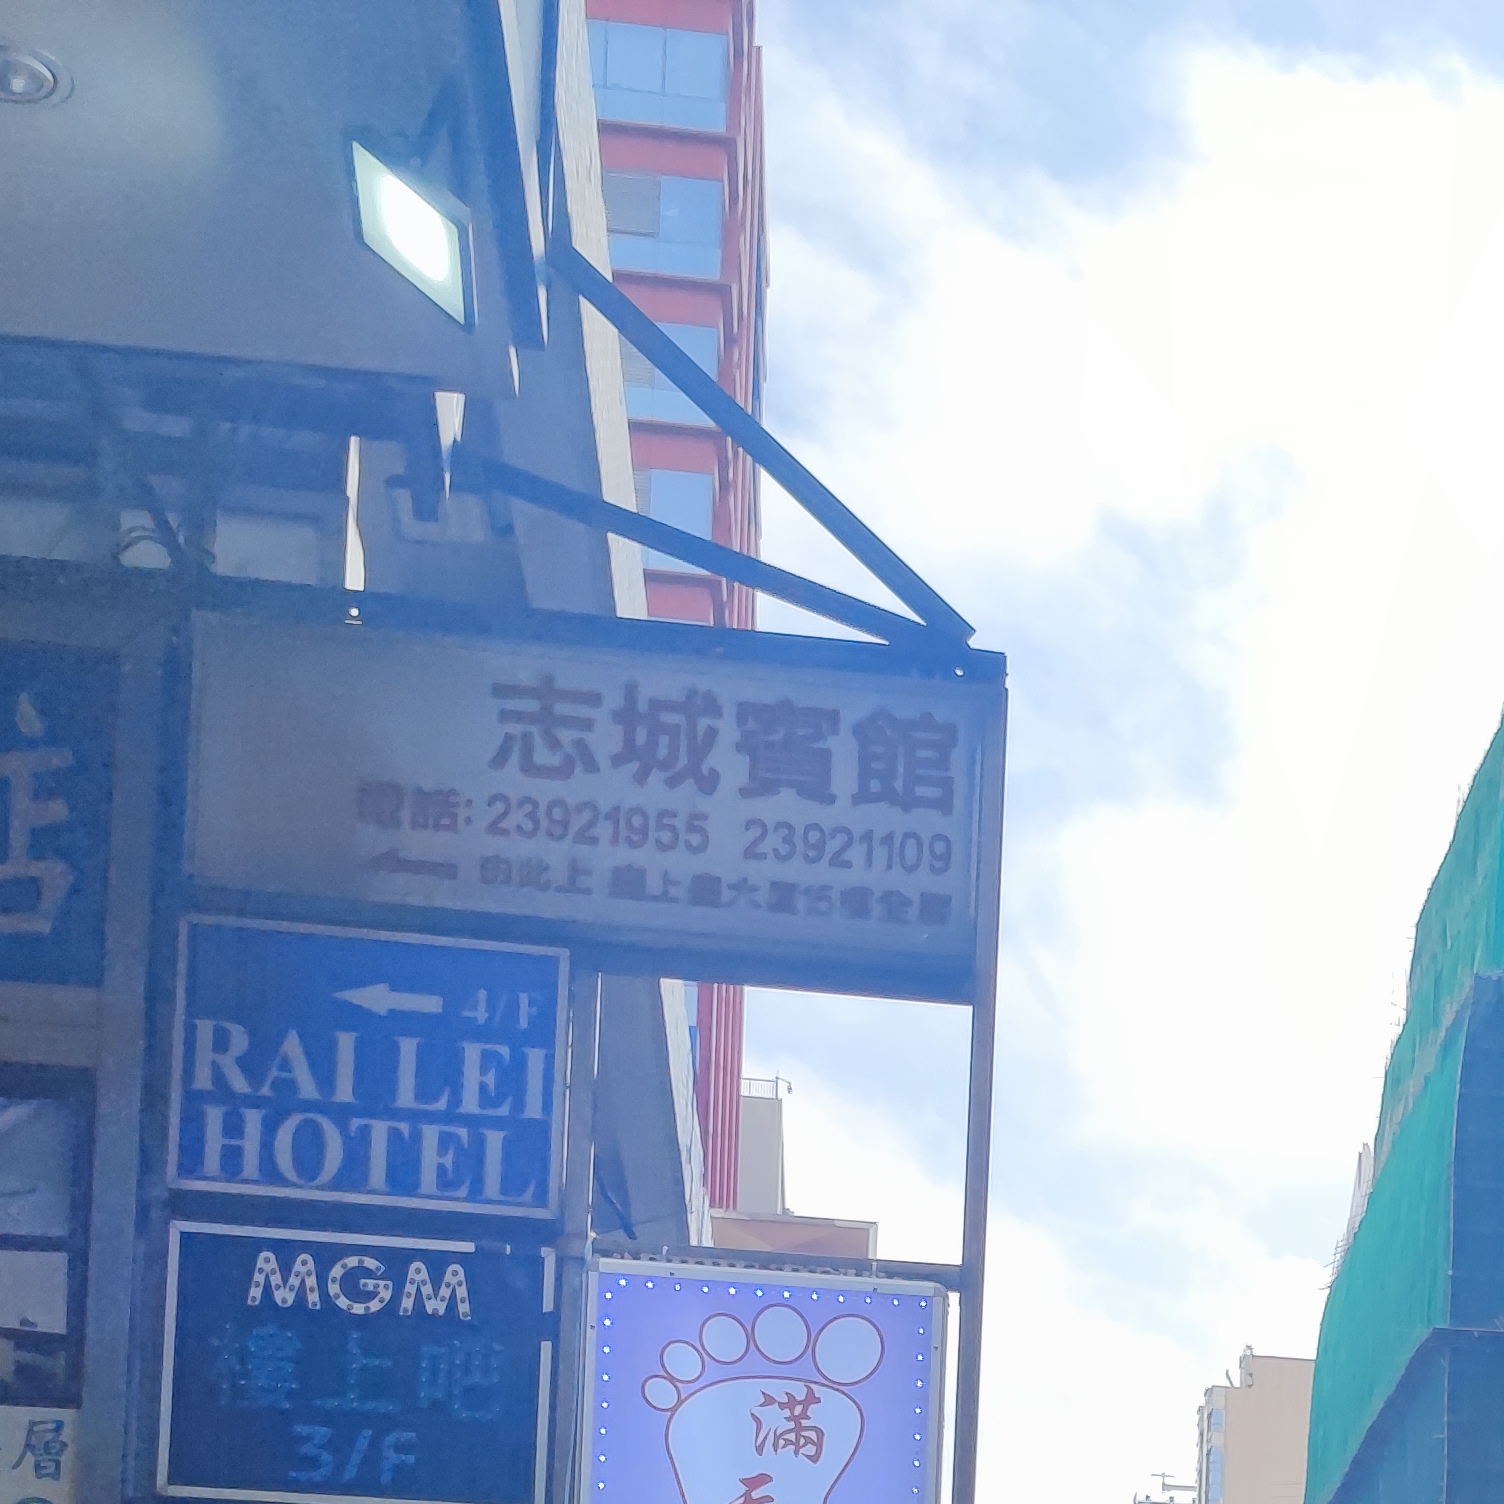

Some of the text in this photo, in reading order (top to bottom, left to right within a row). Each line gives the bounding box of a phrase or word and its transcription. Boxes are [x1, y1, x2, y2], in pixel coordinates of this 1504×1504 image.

[490, 673, 959, 817] 志城賓館
[484, 794, 710, 855] 23921955
[742, 817, 952, 875] 23921109
[190, 1017, 549, 1121] RAI LEI
[201, 1106, 536, 1203] HOTEL
[247, 1251, 471, 1320] MGM
[288, 1424, 417, 1486] 3/F
